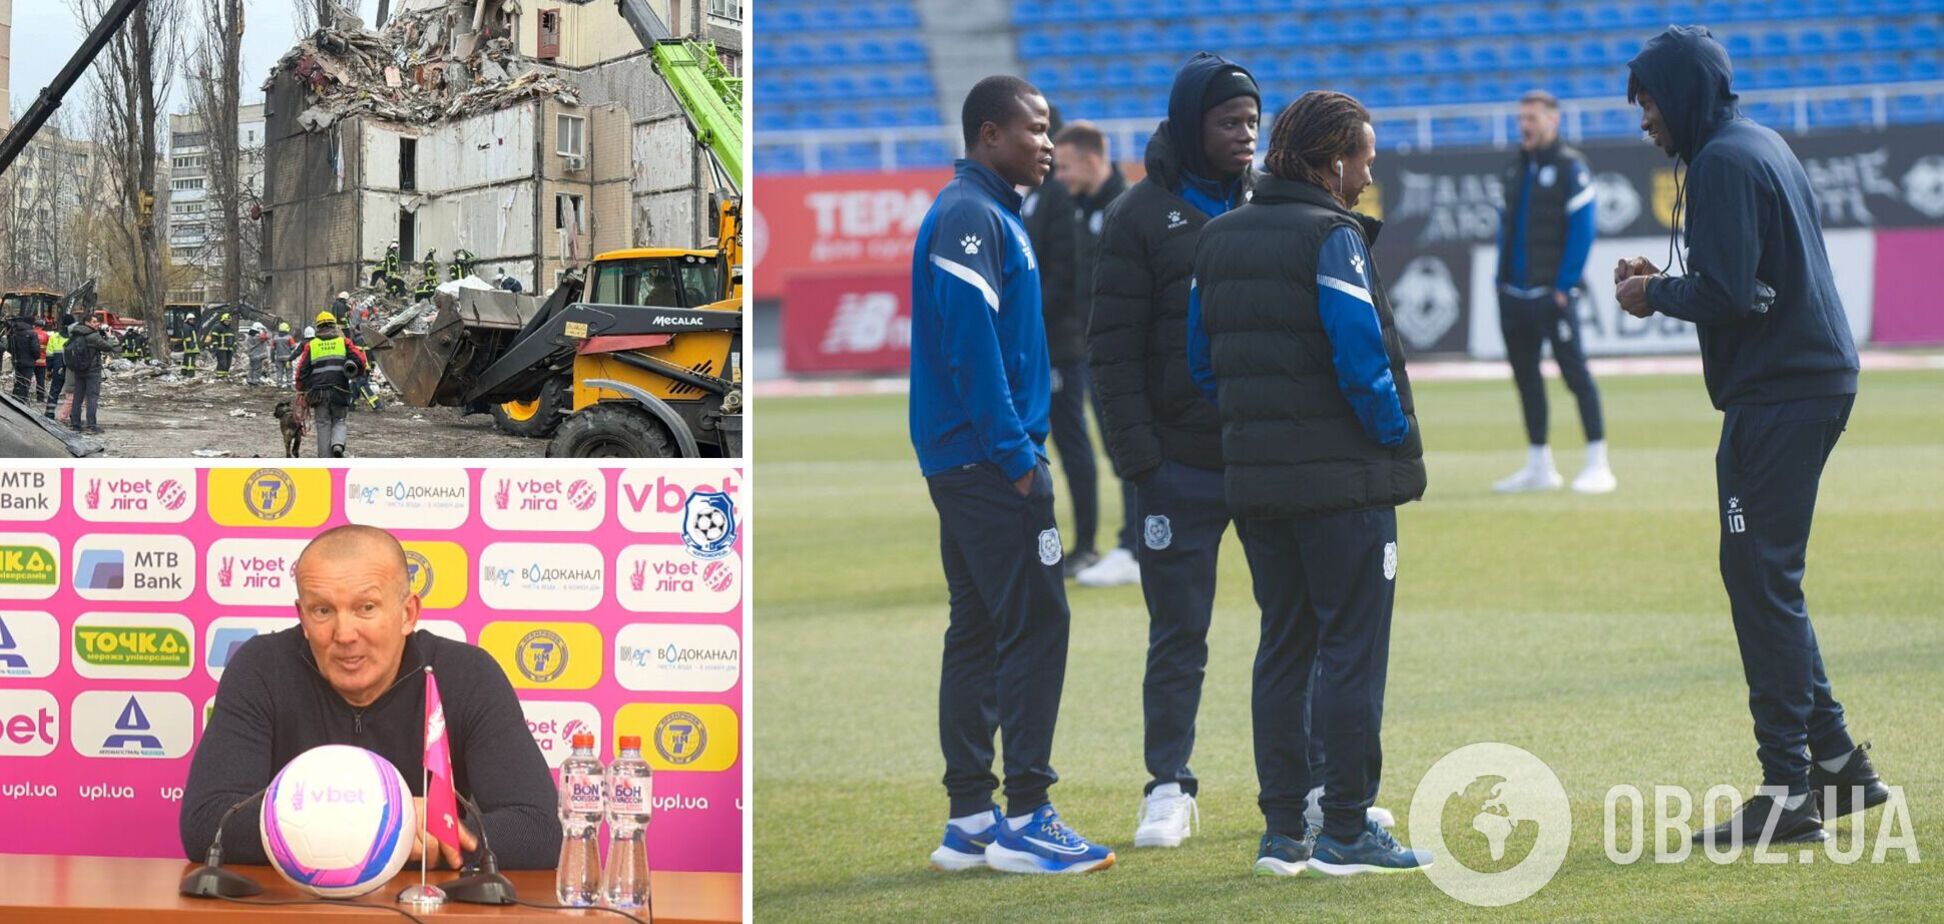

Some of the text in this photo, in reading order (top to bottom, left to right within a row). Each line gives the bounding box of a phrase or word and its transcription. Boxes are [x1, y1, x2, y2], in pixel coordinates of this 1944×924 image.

[1, 472, 45, 488] MTB
[108, 479, 152, 493] vbet
[517, 480, 562, 494] vbet
[0, 494, 49, 509] Bank
[111, 496, 148, 510] ліга
[520, 496, 558, 510] ліга
[1728, 514, 1745, 533] 10
[135, 552, 178, 567] MTB
[241, 557, 285, 571] vbet
[653, 560, 698, 575] vbet
[134, 573, 182, 589] Bank
[243, 575, 281, 588] ліга
[656, 577, 693, 592] ліга
[2, 781, 57, 799] upl.ua
[80, 783, 134, 800] upl.ua
[311, 787, 365, 804] vbet
[573, 784, 599, 795] BON
[652, 793, 708, 812] upl.ua
